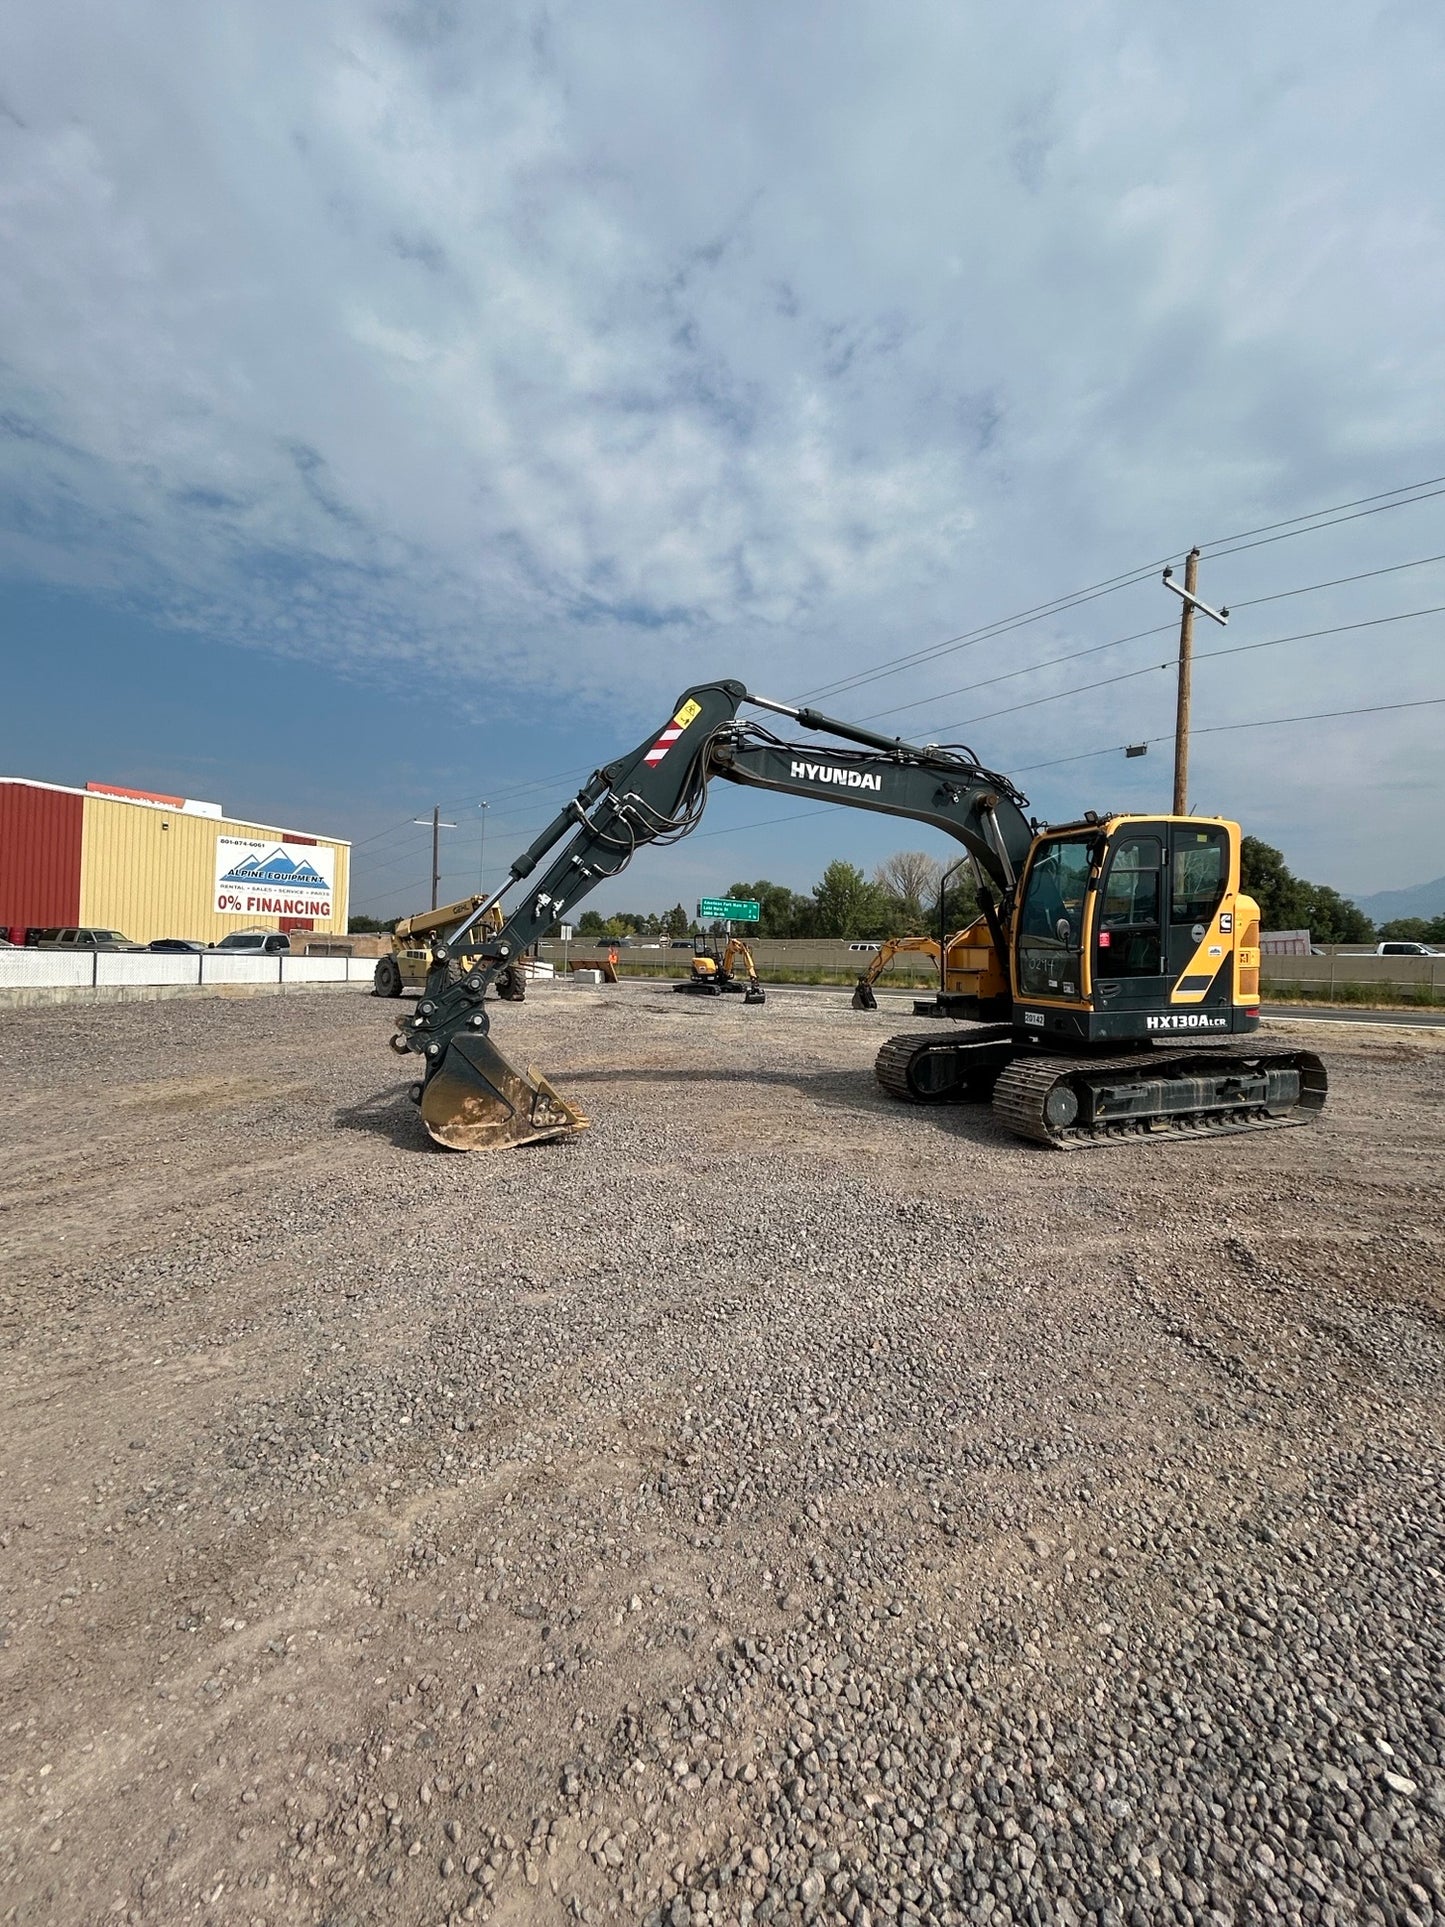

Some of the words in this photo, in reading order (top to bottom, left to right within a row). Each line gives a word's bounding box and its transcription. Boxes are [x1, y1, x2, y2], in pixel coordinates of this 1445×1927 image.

[790, 761, 881, 790] HYUNDAI
[228, 869, 265, 878] ALPINE
[267, 871, 324, 883] EQUIPMENT
[218, 895, 241, 910] 0%
[247, 896, 330, 915] FINANCING
[453, 904, 469, 914] GEHL
